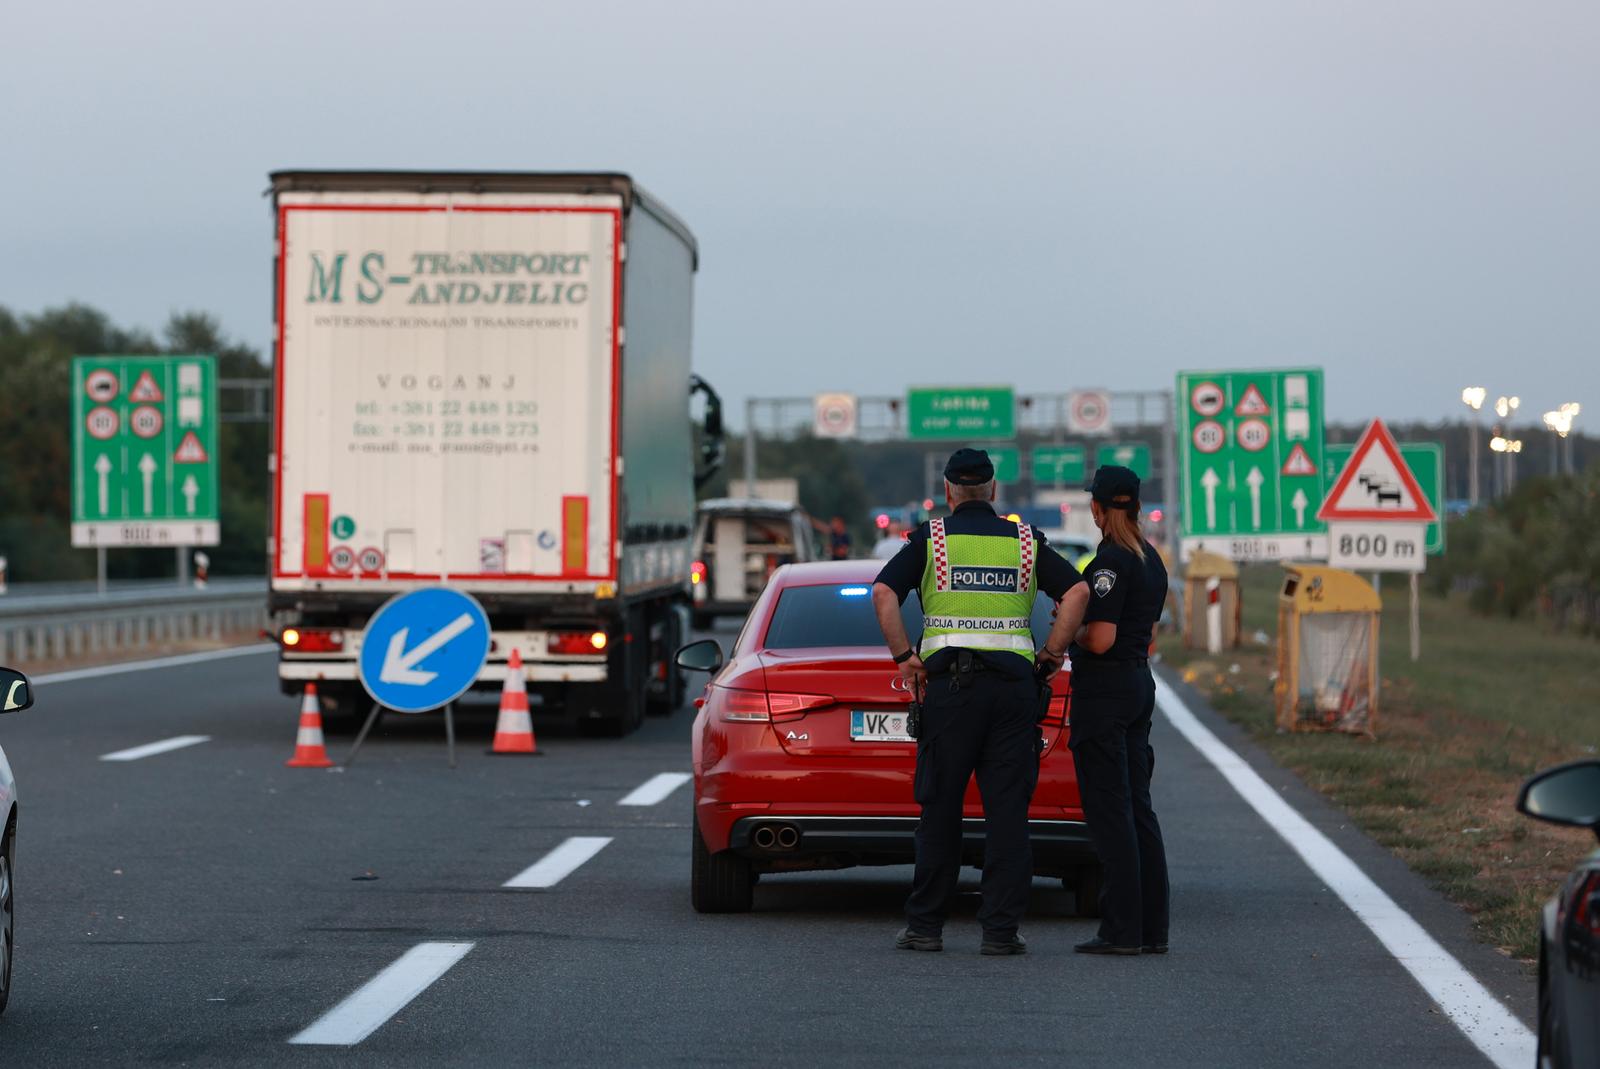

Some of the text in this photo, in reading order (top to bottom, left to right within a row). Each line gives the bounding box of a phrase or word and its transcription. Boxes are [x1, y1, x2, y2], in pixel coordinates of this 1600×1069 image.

[408, 282, 589, 304] ANDJELIC
[336, 519, 349, 537] L
[1339, 534, 1415, 557] 800 m
[953, 571, 1015, 587] POLICIJA
[957, 619, 1005, 630] POLICIJA
[866, 714, 890, 735] VK
[786, 730, 808, 740] A4
